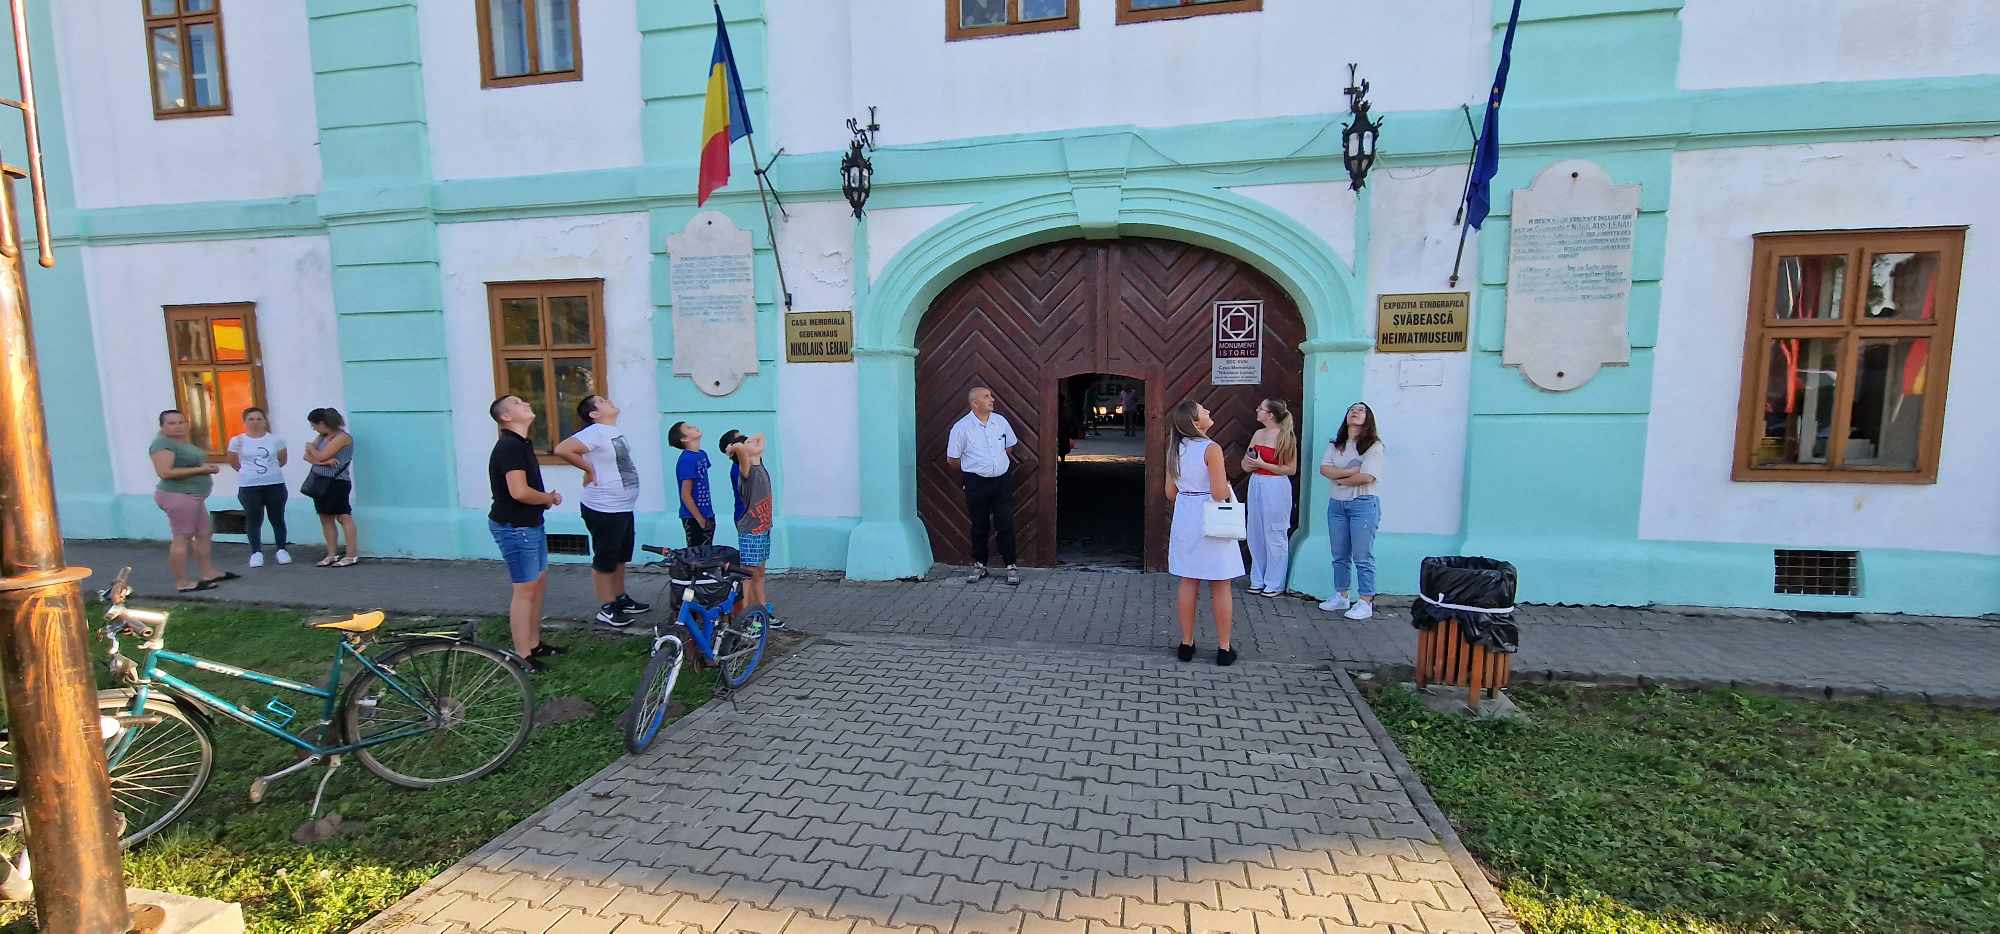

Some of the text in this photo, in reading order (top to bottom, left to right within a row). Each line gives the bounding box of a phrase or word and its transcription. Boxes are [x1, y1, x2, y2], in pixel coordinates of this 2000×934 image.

[791, 319, 807, 327] CASA
[799, 330, 838, 338] GEDENKHAUS
[1382, 331, 1463, 345] HEIMATMUSEUM
[790, 341, 849, 356] NIKOLAUS LENAU
